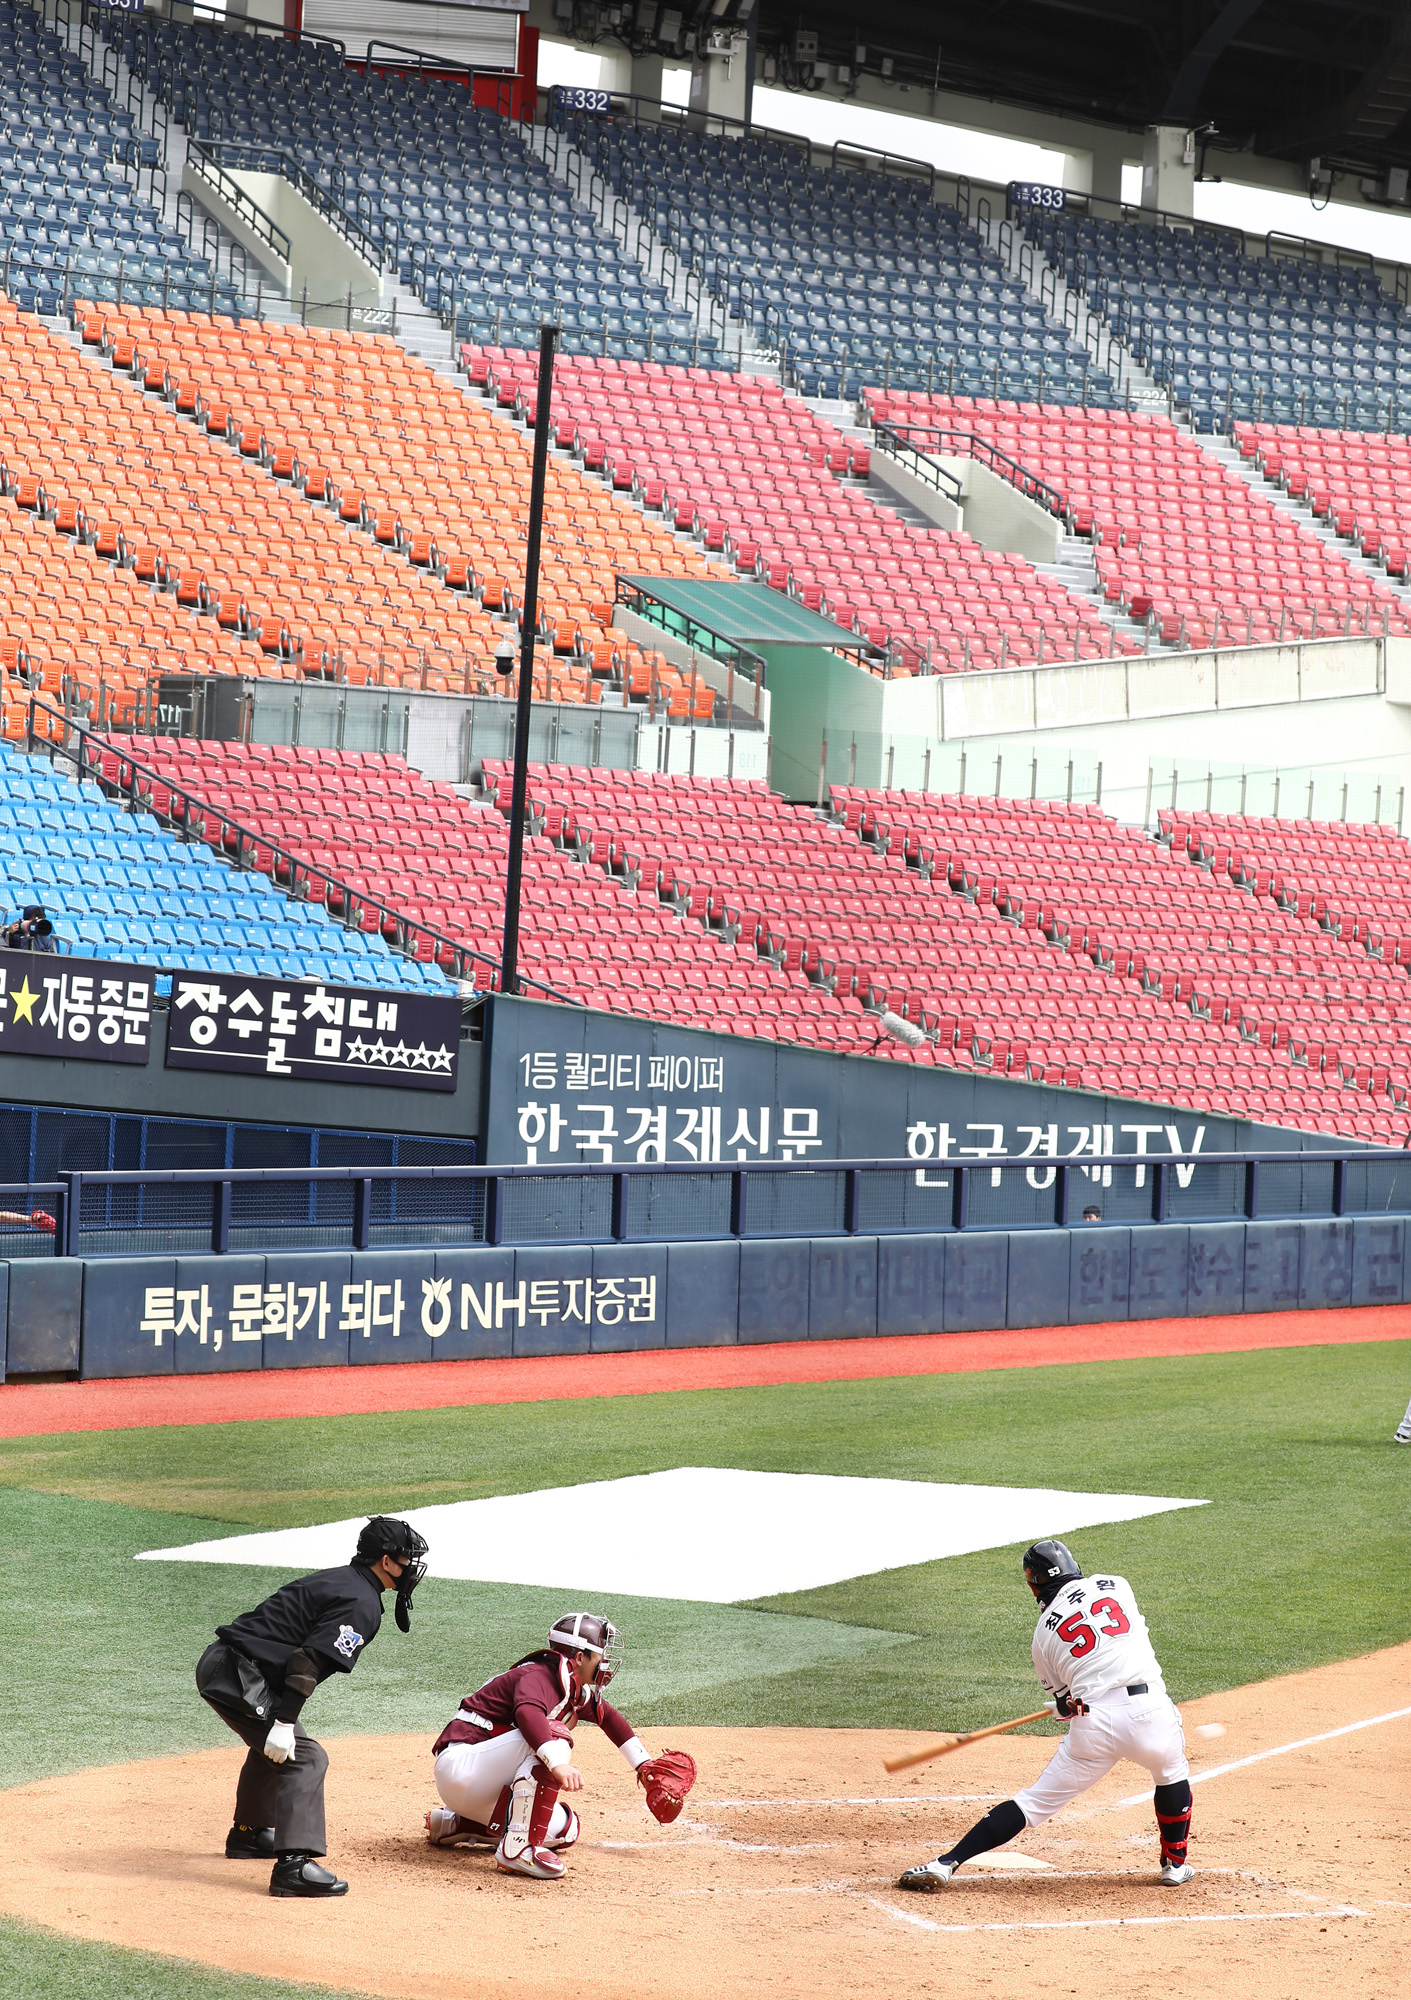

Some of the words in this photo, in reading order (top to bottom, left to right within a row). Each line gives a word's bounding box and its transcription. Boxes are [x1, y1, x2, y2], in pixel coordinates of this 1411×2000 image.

[575, 90, 607, 110] 332
[1031, 186, 1063, 208] 333
[363, 306, 390, 325] 222
[754, 348, 780, 366] 223
[1142, 389, 1168, 406] 224
[39, 973, 151, 1046] 자동중문
[174, 981, 399, 1074] 장수돌침대
[519, 1052, 559, 1090] 1등
[563, 1052, 641, 1092] 퀄리티
[647, 1054, 724, 1093] 페이퍼
[517, 1101, 823, 1166] 한국경제신문
[906, 1121, 1206, 1189] 한국경제TV
[1271, 1222, 1402, 1302] 고창군
[140, 1284, 223, 1352] 투자,
[228, 1281, 331, 1342] 문화가
[338, 1279, 405, 1338] 되다
[460, 1275, 656, 1331] NH투자증권
[1047, 1566, 1061, 1577] 53
[1055, 1597, 1134, 1659] 53
